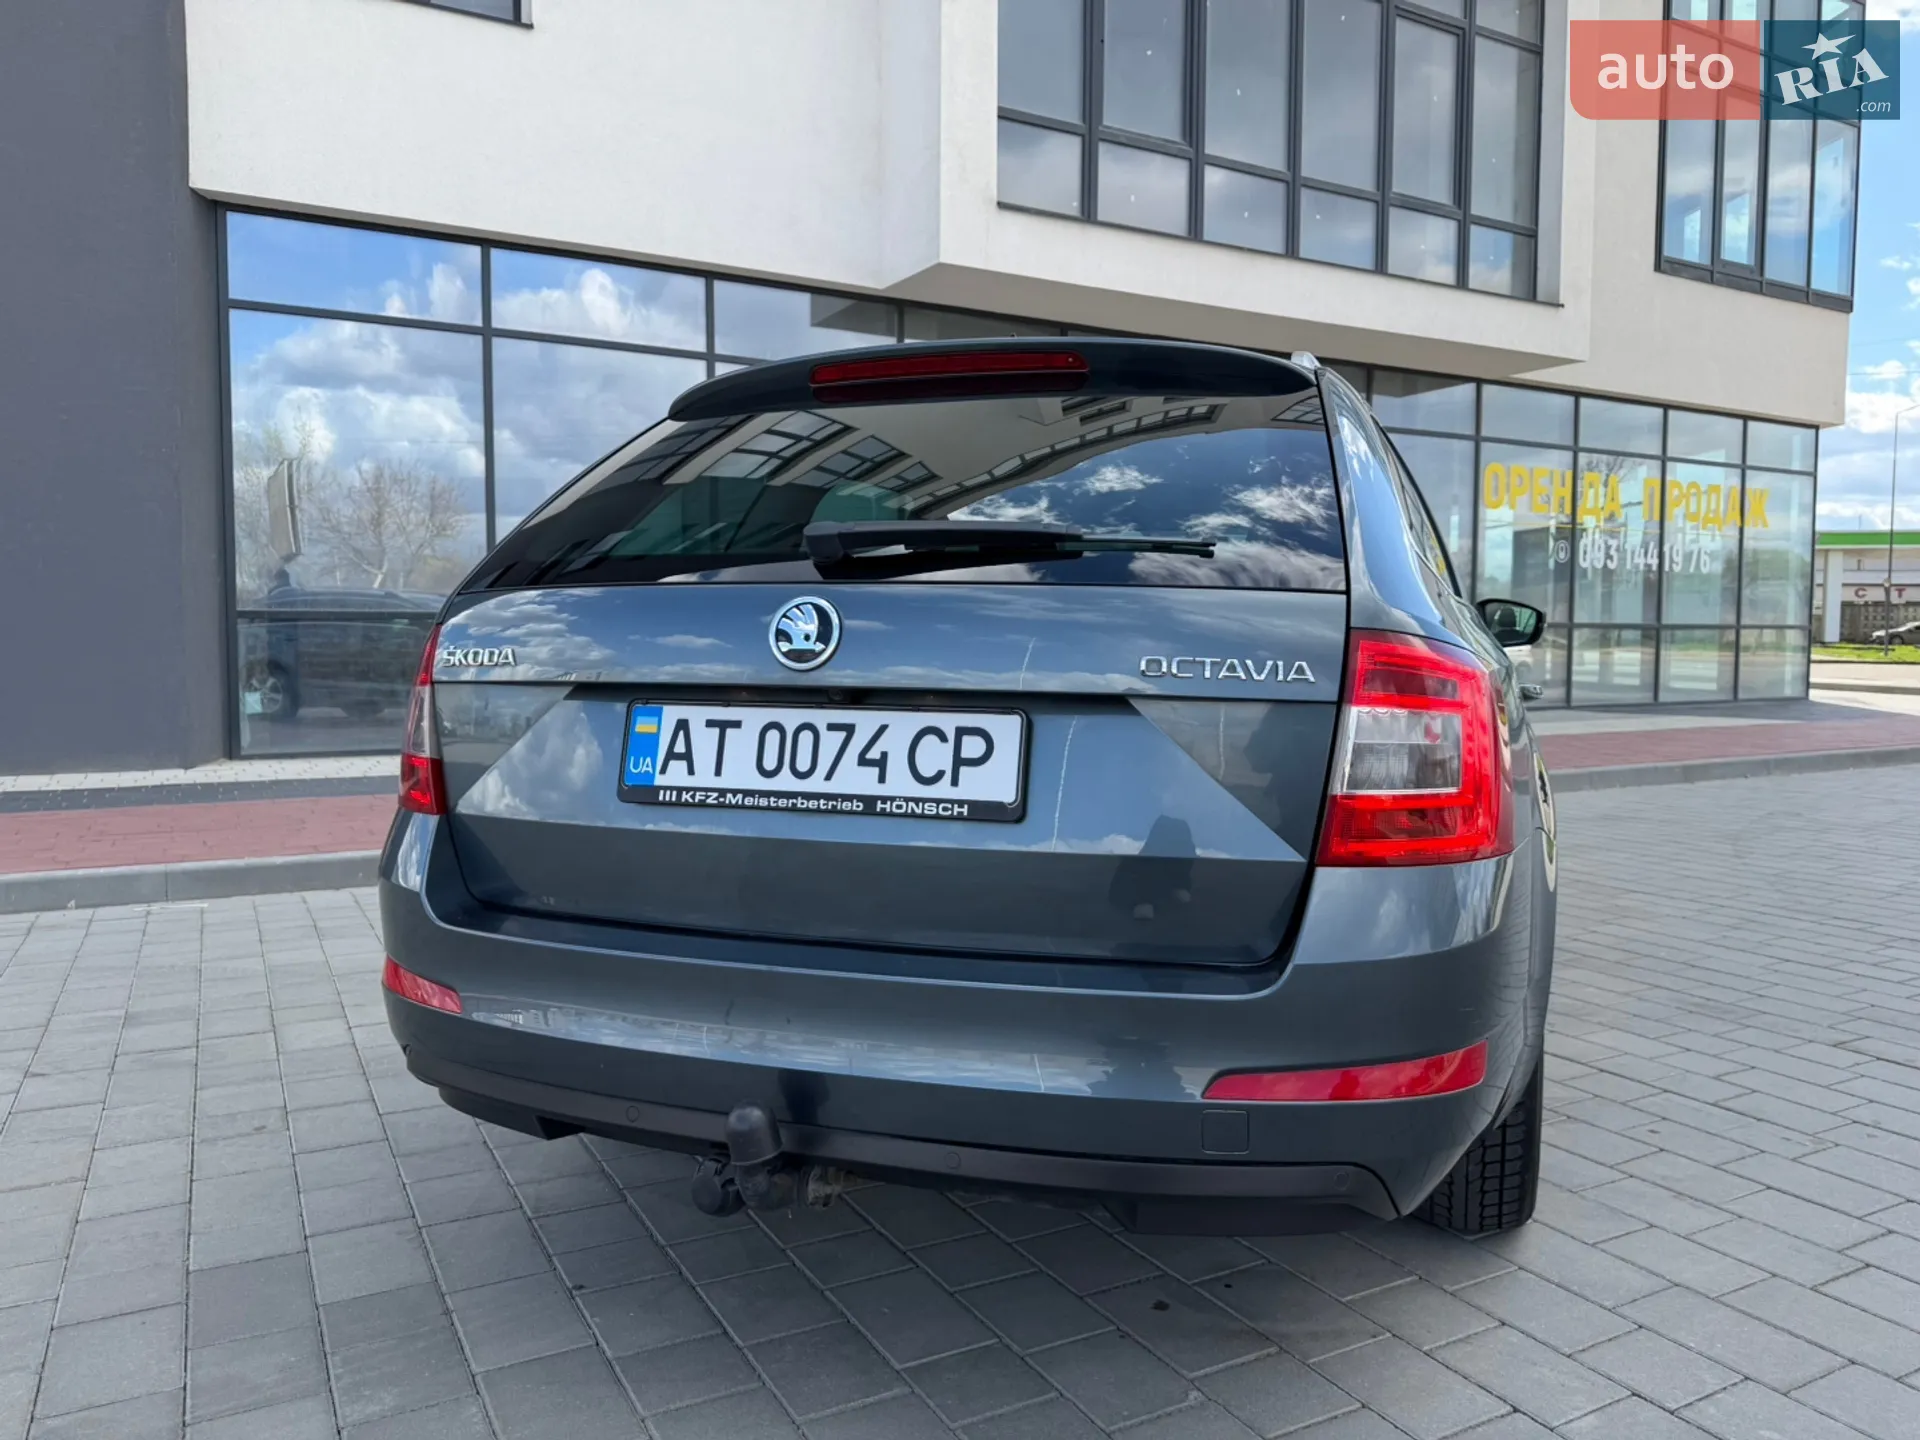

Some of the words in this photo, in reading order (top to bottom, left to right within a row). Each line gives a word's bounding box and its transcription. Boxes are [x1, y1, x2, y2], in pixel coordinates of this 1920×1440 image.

[1482, 462, 1623, 523] ОРЕНДА
[1642, 477, 1770, 531] ПРОДАЖ
[1139, 655, 1316, 683] OCTAVIA
[630, 756, 653, 774] UA
[659, 718, 743, 777] AT
[755, 721, 890, 784] 0074
[907, 725, 995, 787] CP
[681, 790, 864, 812] KFZ-Meisterbetrieb
[876, 798, 968, 816] HÖNSCH
